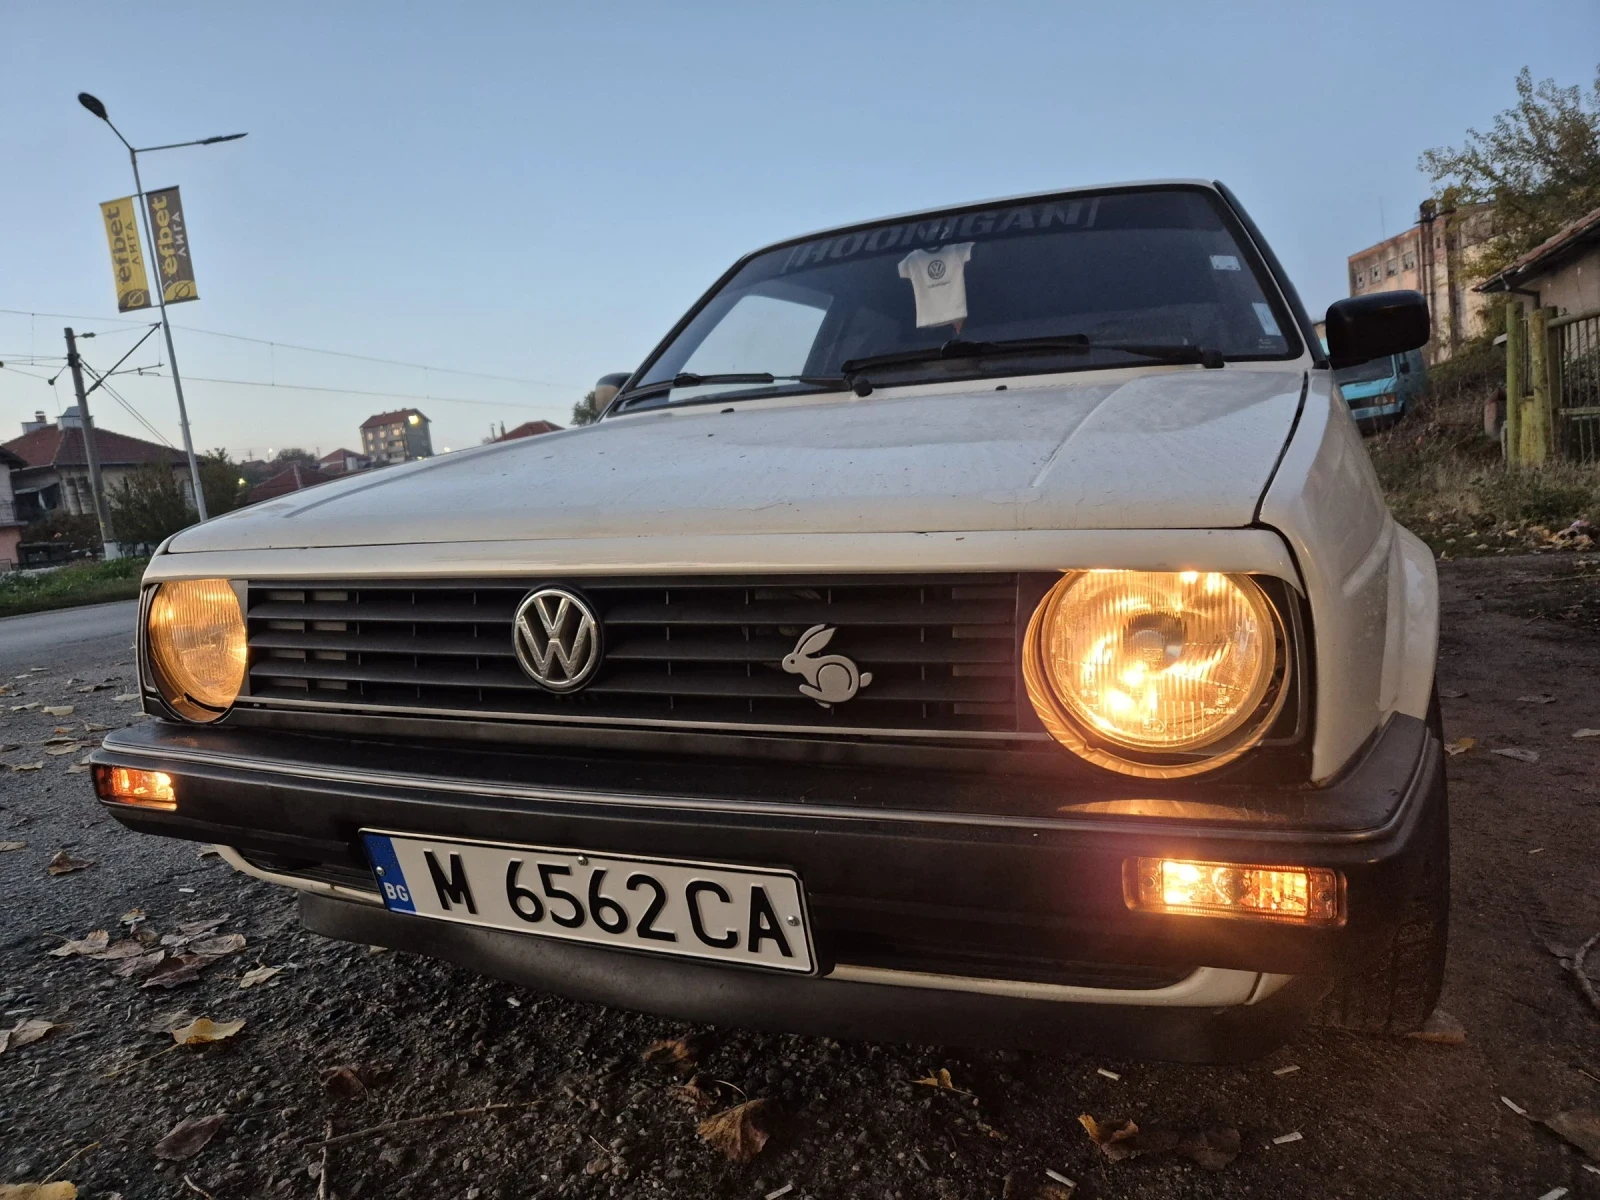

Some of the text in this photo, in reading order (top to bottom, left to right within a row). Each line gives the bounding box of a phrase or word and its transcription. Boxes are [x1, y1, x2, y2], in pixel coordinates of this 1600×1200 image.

[106, 206, 132, 283] efbet
[125, 221, 141, 266] ЛИГА
[151, 195, 179, 276] efbet
[172, 211, 187, 257] ЛИГА
[514, 588, 598, 689] VW
[383, 881, 410, 902] BG
